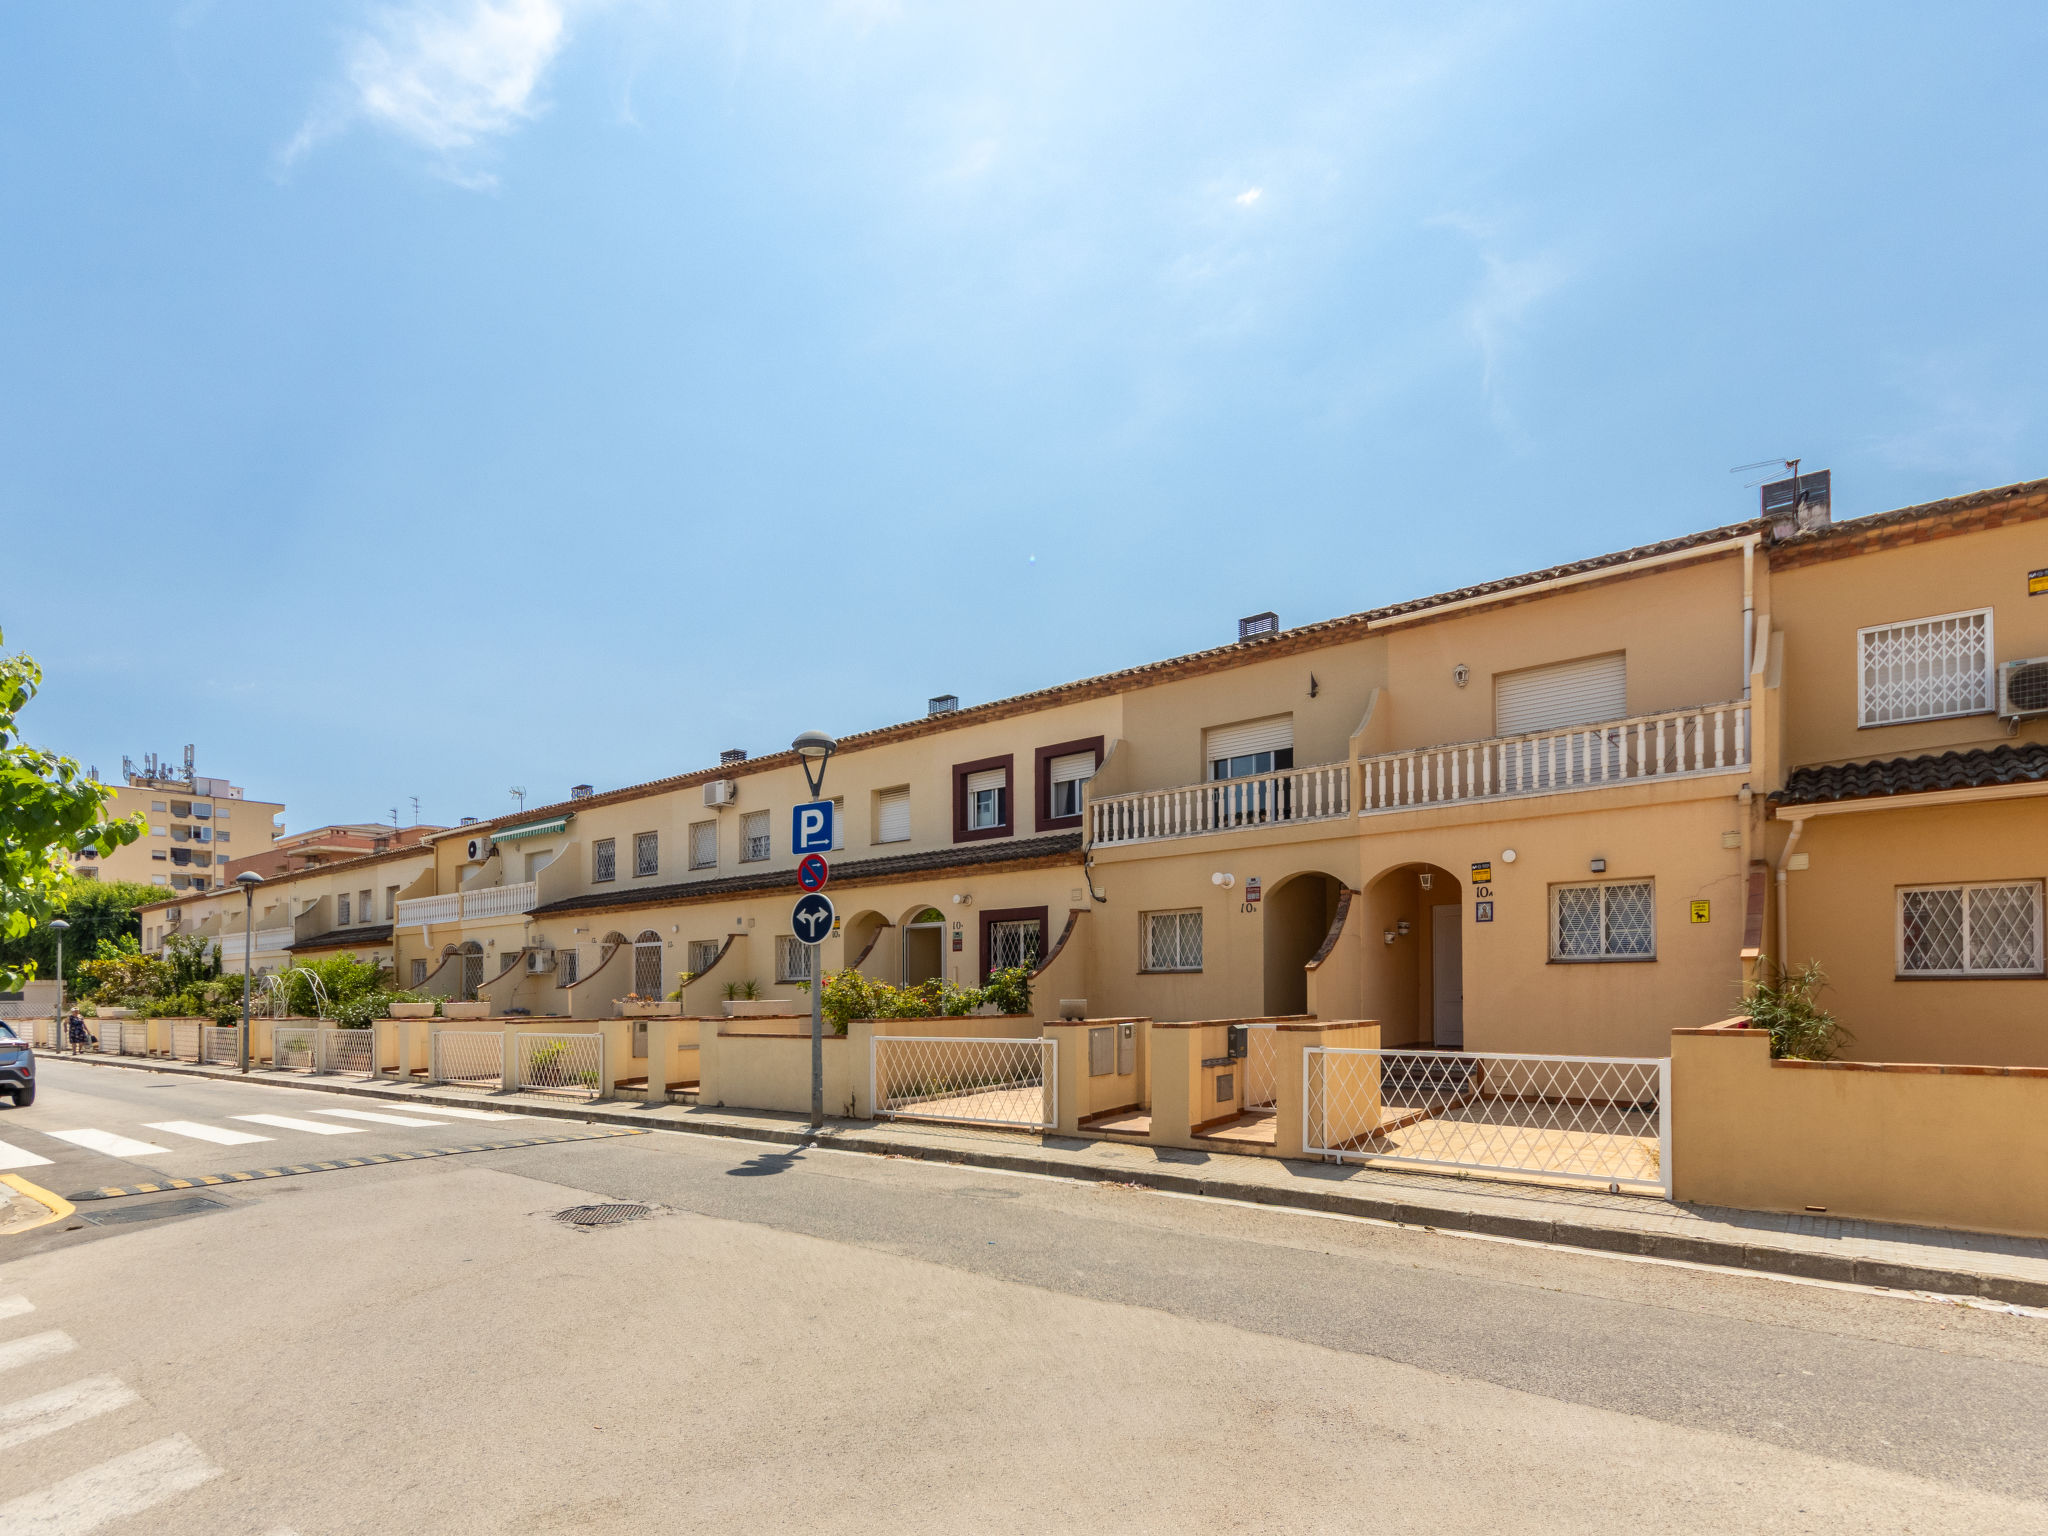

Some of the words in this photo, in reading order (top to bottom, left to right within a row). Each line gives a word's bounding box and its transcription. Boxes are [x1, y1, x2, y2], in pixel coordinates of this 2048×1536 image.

[801, 809, 824, 848] P
[1476, 886, 1493, 898] 10A
[952, 921, 963, 930] 10
